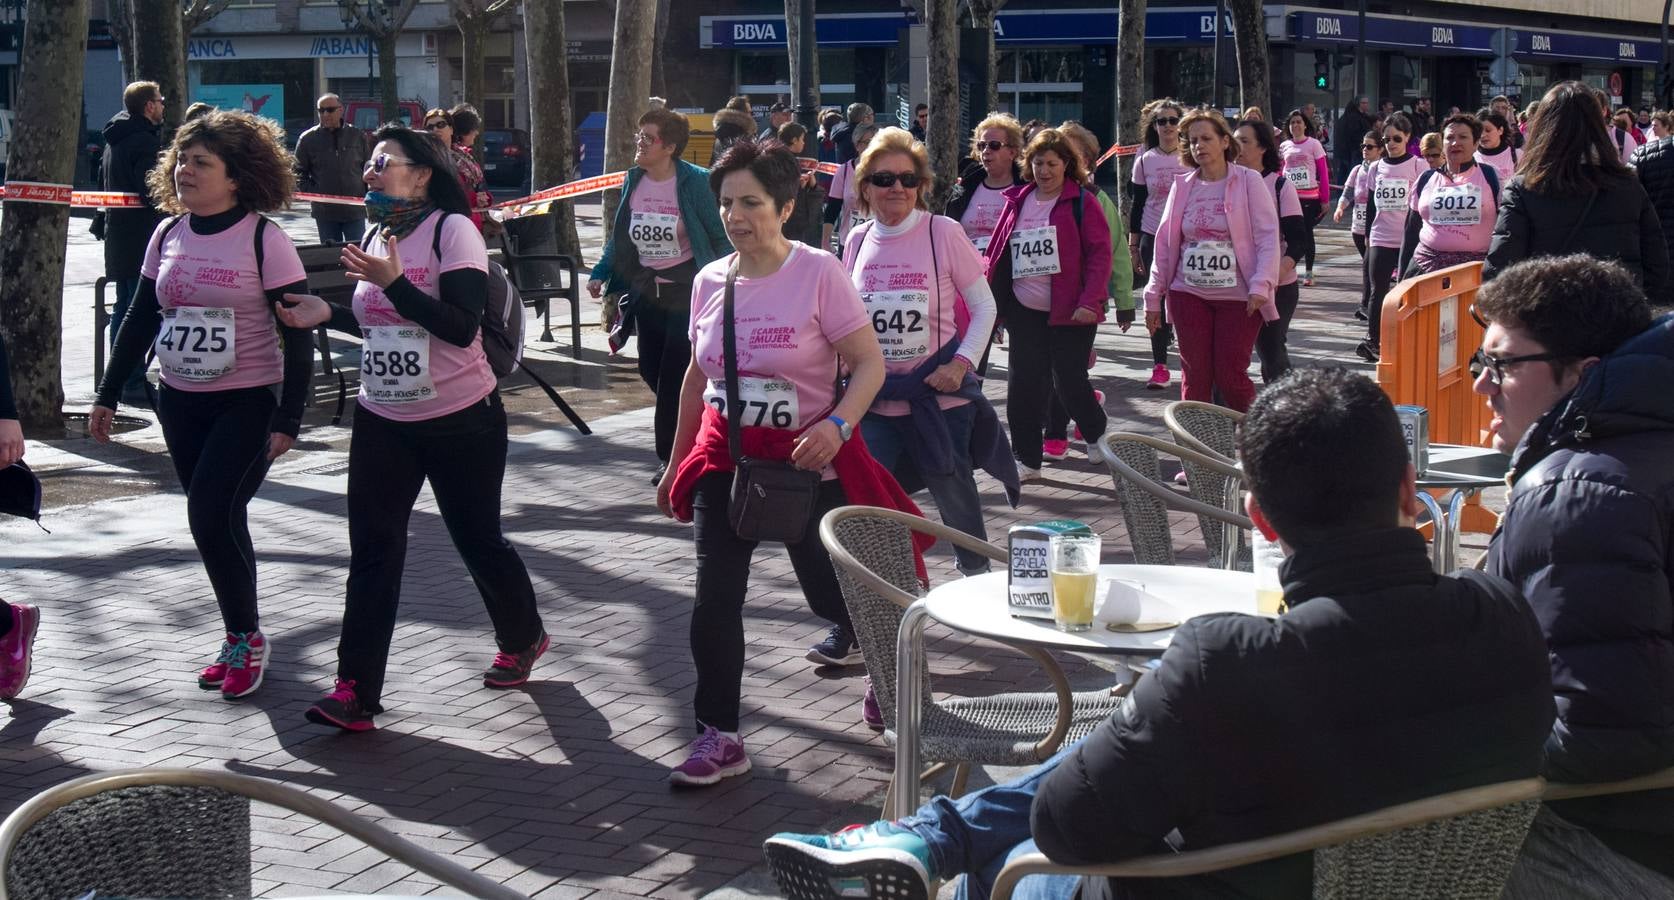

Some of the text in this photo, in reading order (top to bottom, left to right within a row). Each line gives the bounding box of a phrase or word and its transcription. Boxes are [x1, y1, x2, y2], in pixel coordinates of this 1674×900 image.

[733, 23, 777, 40] BBVA
[1316, 17, 1341, 35] BBVA
[1432, 26, 1454, 44] BBVA
[1532, 35, 1551, 51] BBVA
[1619, 42, 1637, 58] BBVA
[1375, 187, 1406, 199] 6619
[1433, 195, 1478, 210] 3012
[631, 224, 674, 242] 6886
[1012, 238, 1055, 260] 7448
[1186, 254, 1232, 271] 4140
[200, 272, 236, 284] MUJER
[202, 267, 241, 278] CARRERA
[895, 272, 928, 280] CARRERA
[892, 279, 925, 287] MUJER
[866, 308, 924, 335] 642
[757, 326, 796, 335] CARRERA
[160, 325, 228, 353] 4725
[754, 335, 791, 344] MUJER
[363, 350, 422, 377] 3588
